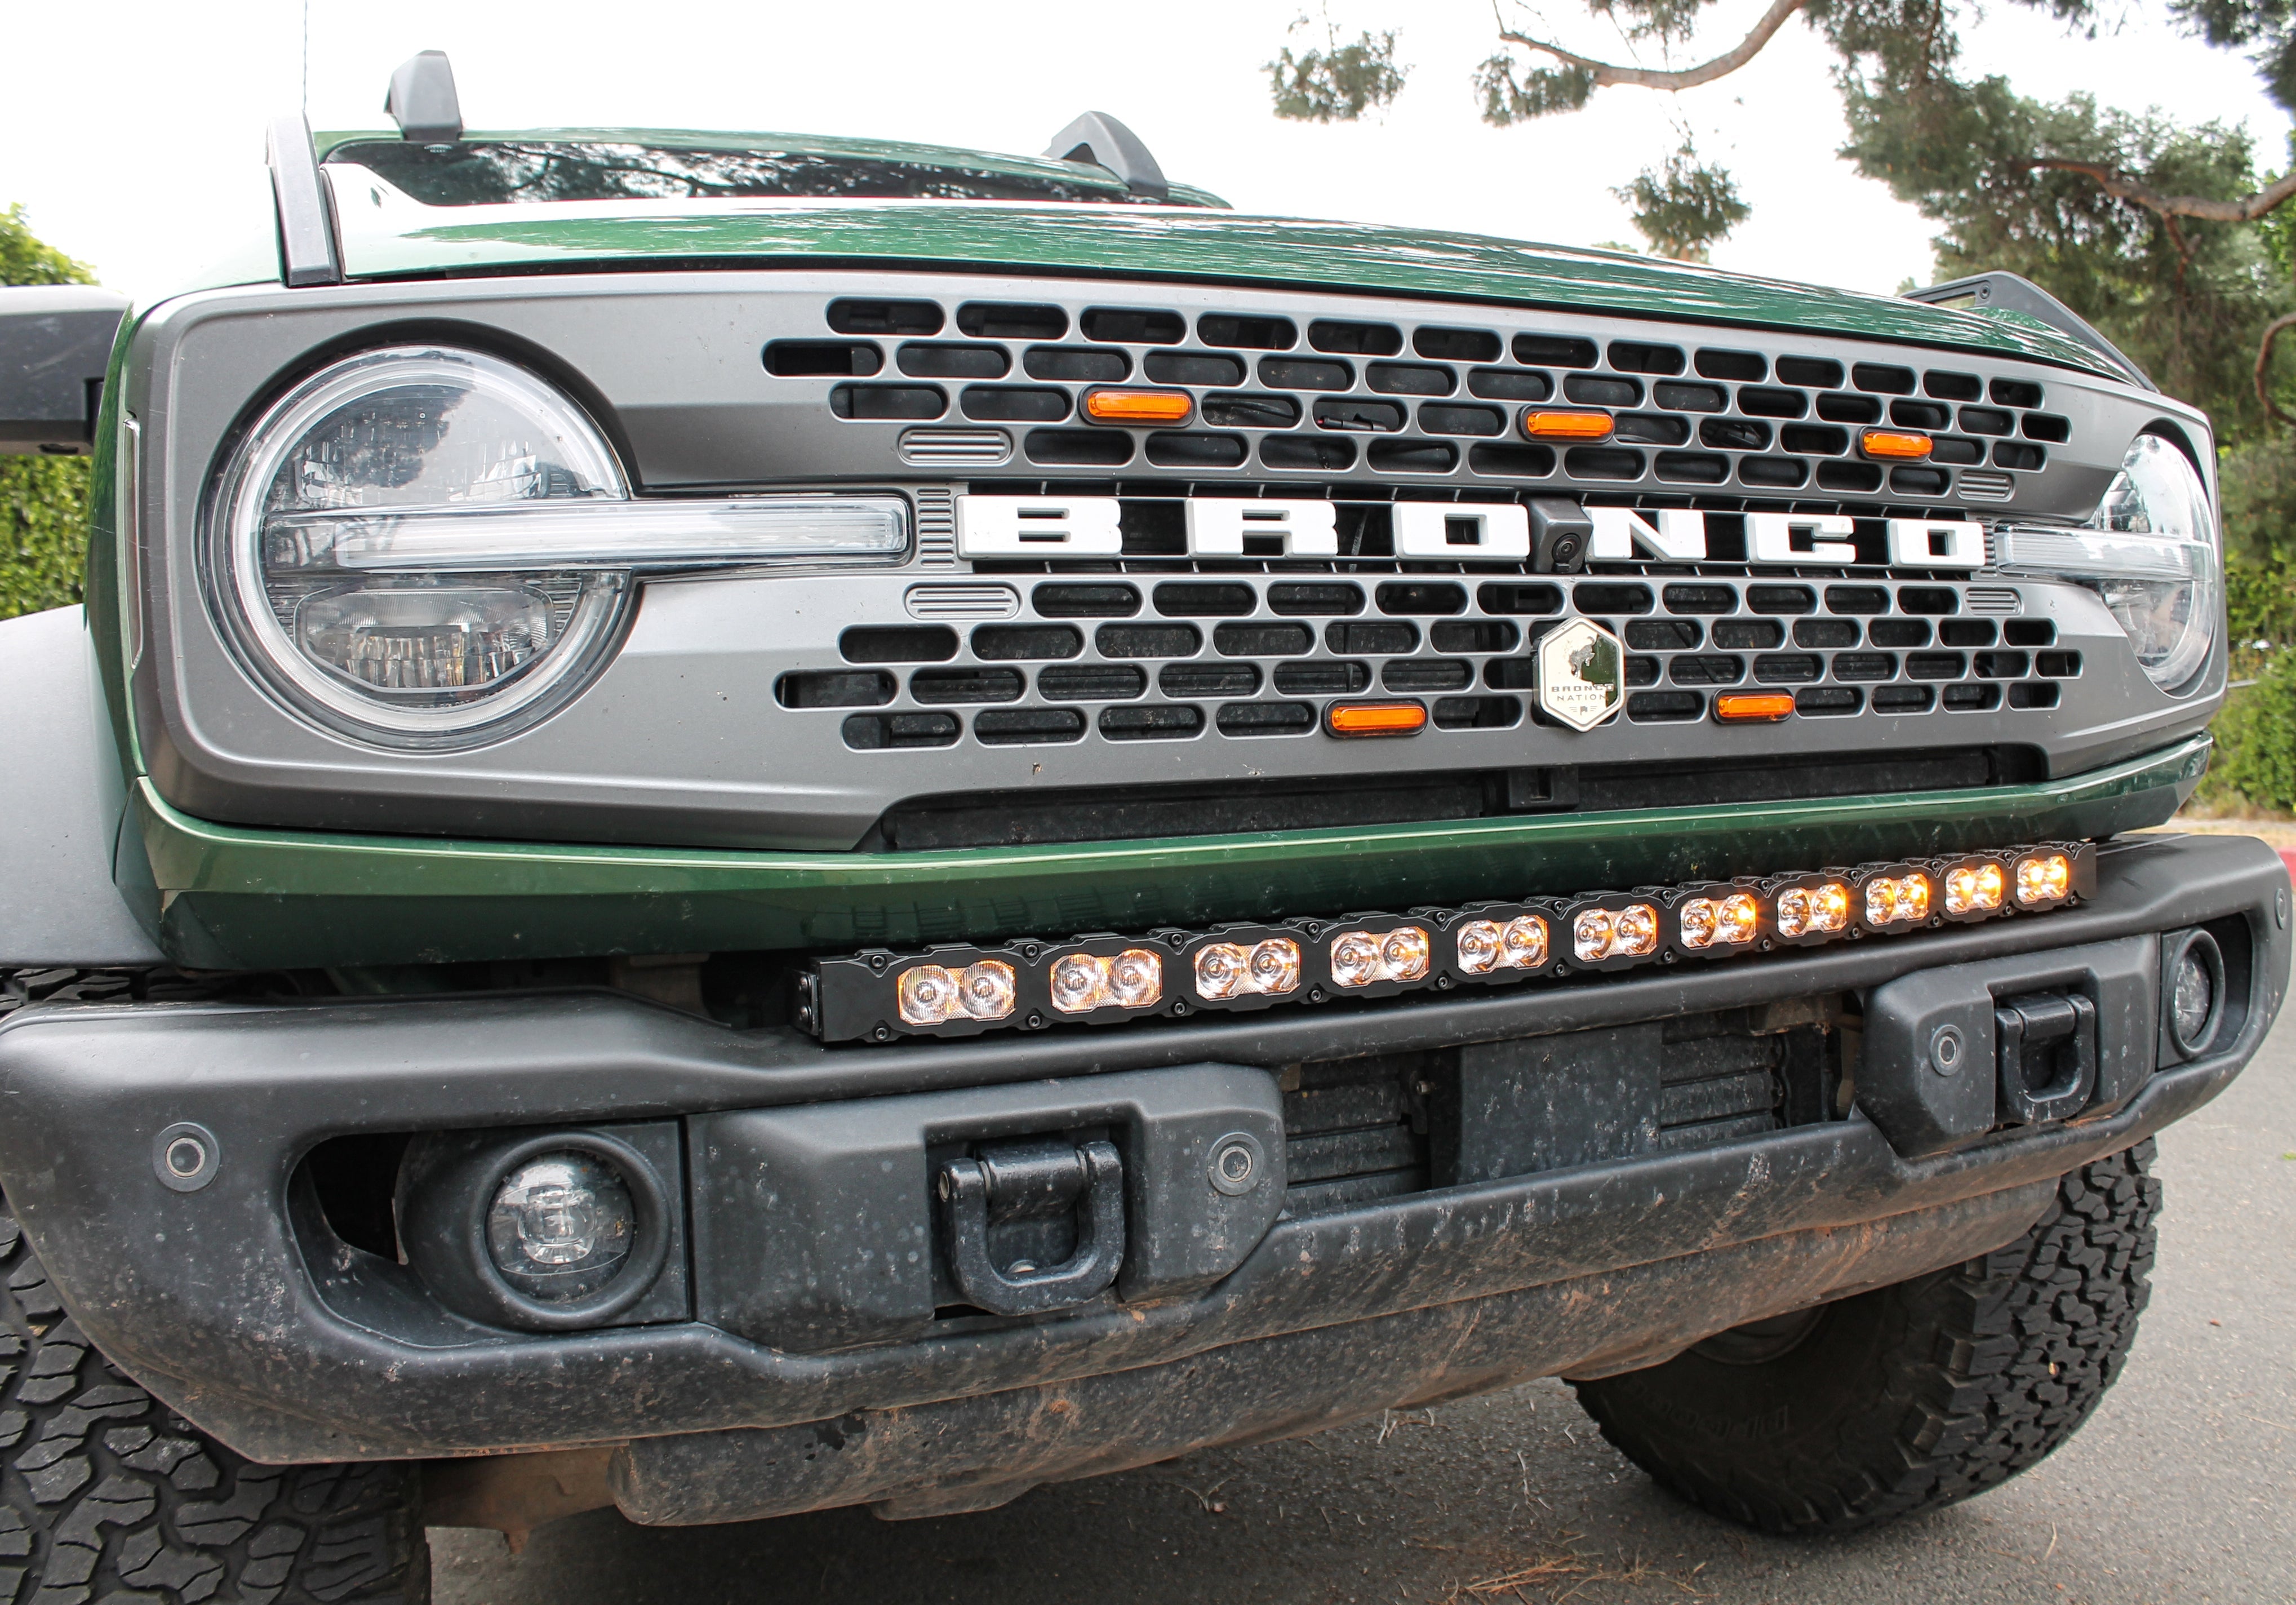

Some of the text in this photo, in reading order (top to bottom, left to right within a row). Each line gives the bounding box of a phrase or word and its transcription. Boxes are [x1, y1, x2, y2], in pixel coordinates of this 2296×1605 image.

[955, 494, 1986, 572] BRONCO
[1551, 683, 1614, 692] BRONCO
[1557, 693, 1606, 702] NATION
